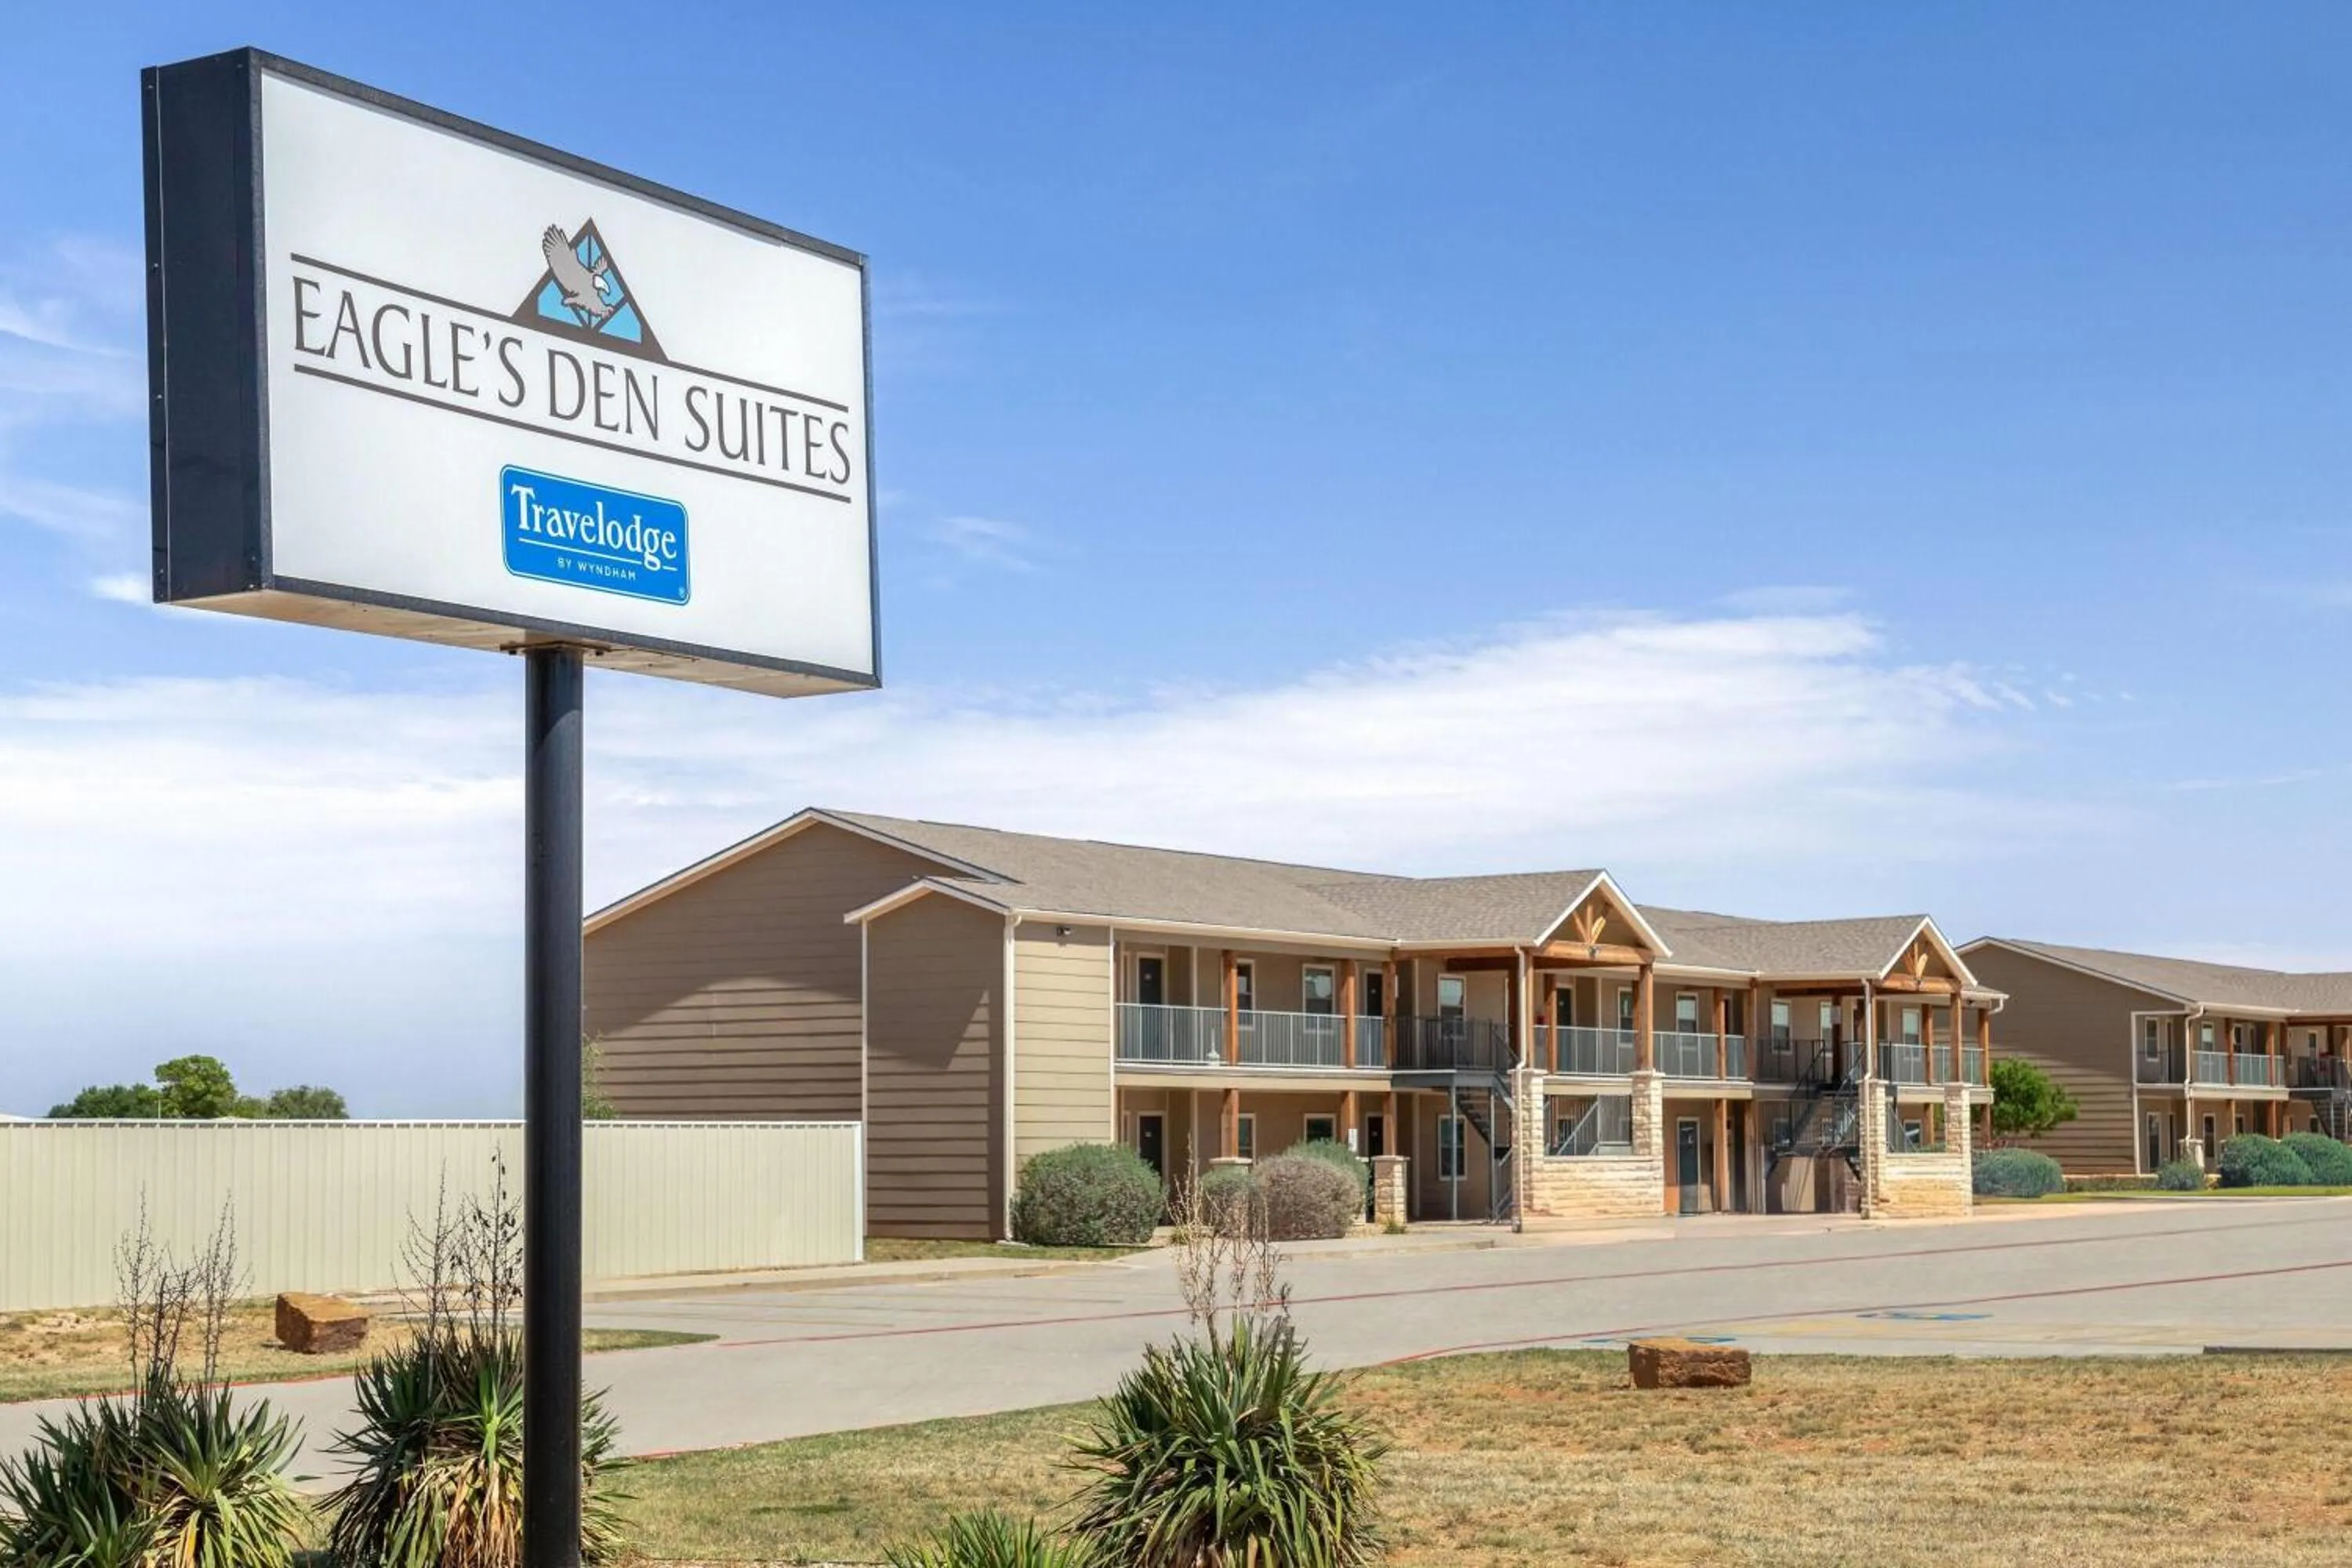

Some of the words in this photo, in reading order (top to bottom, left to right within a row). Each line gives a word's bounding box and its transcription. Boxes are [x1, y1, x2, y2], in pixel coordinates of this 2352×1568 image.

[292, 275, 526, 408] EAGLE'S
[546, 350, 659, 441] DEN
[684, 386, 851, 485] SUITES
[510, 484, 678, 572] Travelodge
[557, 557, 572, 571] BY
[577, 560, 637, 582] WYNDHAM
